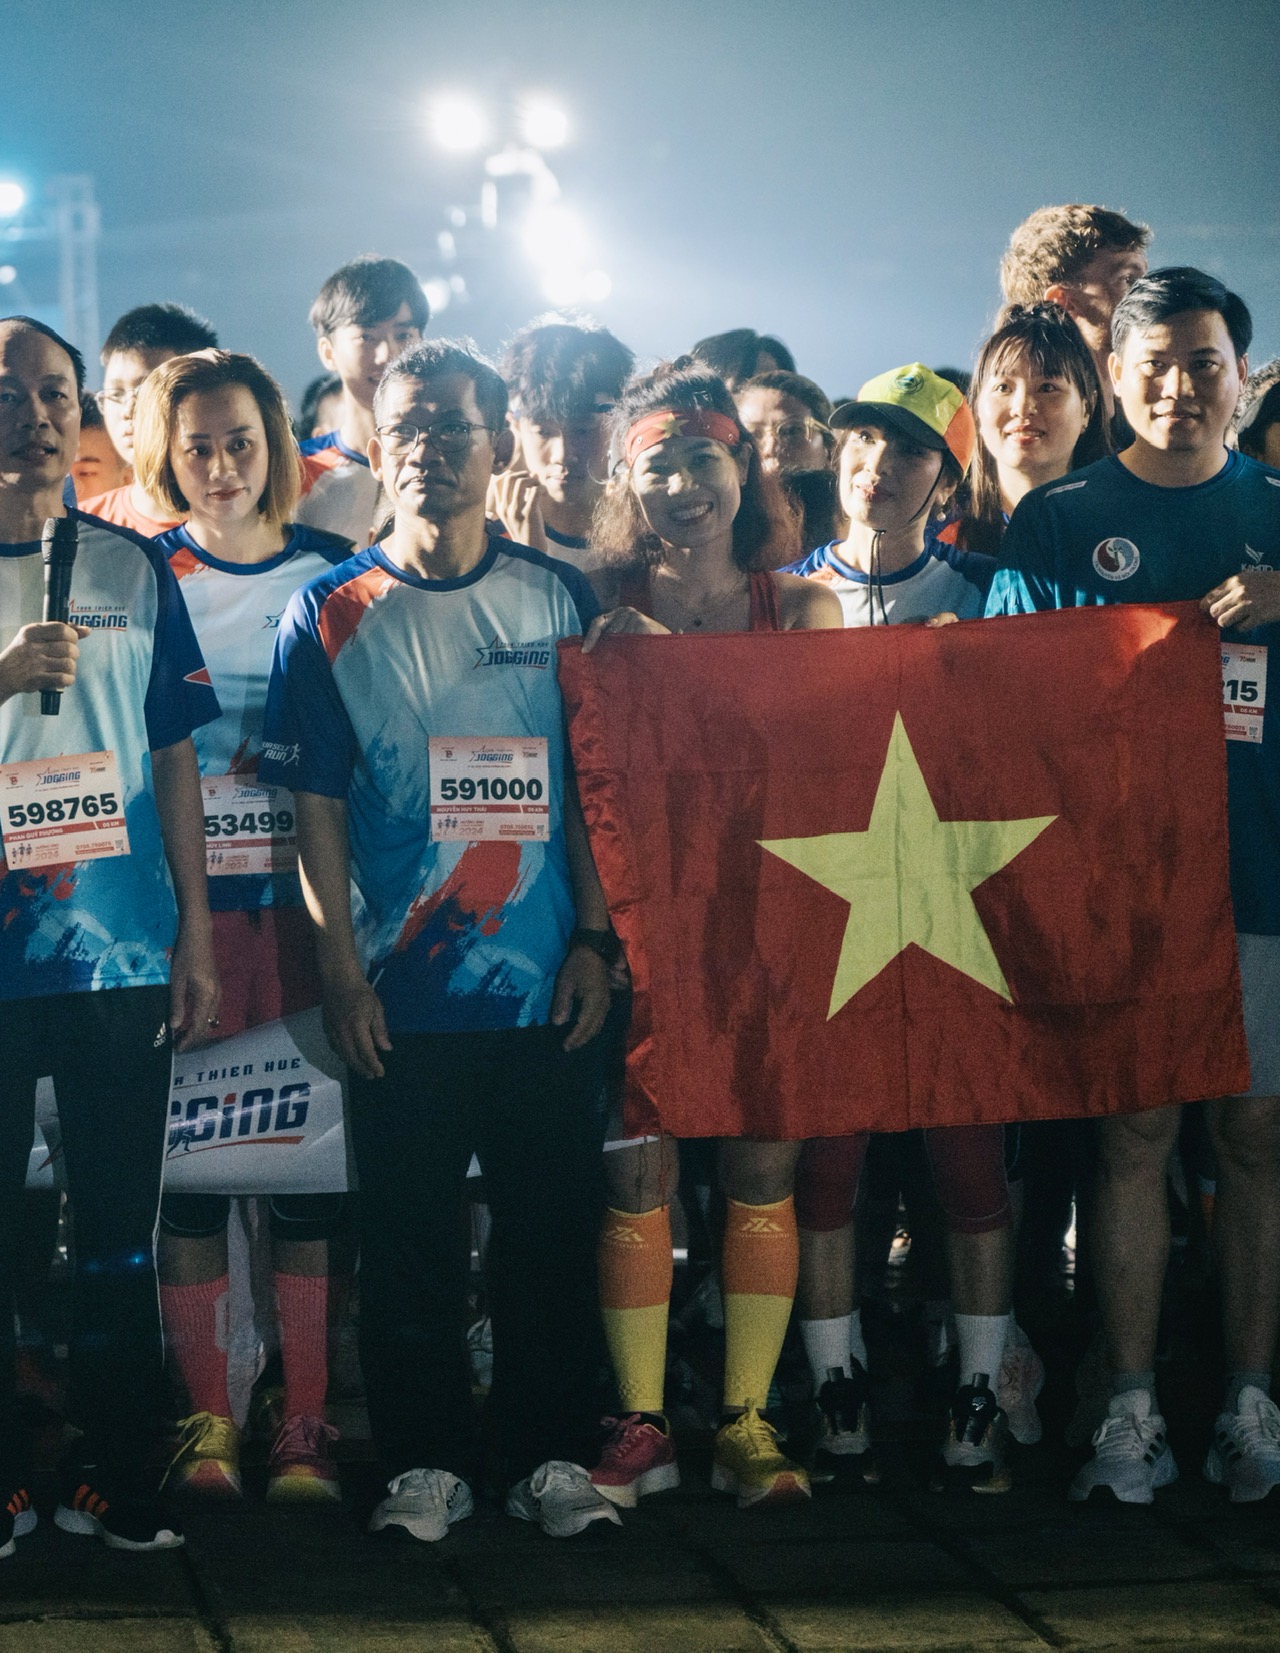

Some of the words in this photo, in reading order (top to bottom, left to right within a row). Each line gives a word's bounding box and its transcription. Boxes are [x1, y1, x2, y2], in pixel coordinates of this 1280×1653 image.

[69, 613, 128, 628] OGGING
[440, 778, 543, 801] 591000
[8, 792, 118, 827] 598765
[204, 811, 294, 837] 53499
[265, 1058, 301, 1074] HUE
